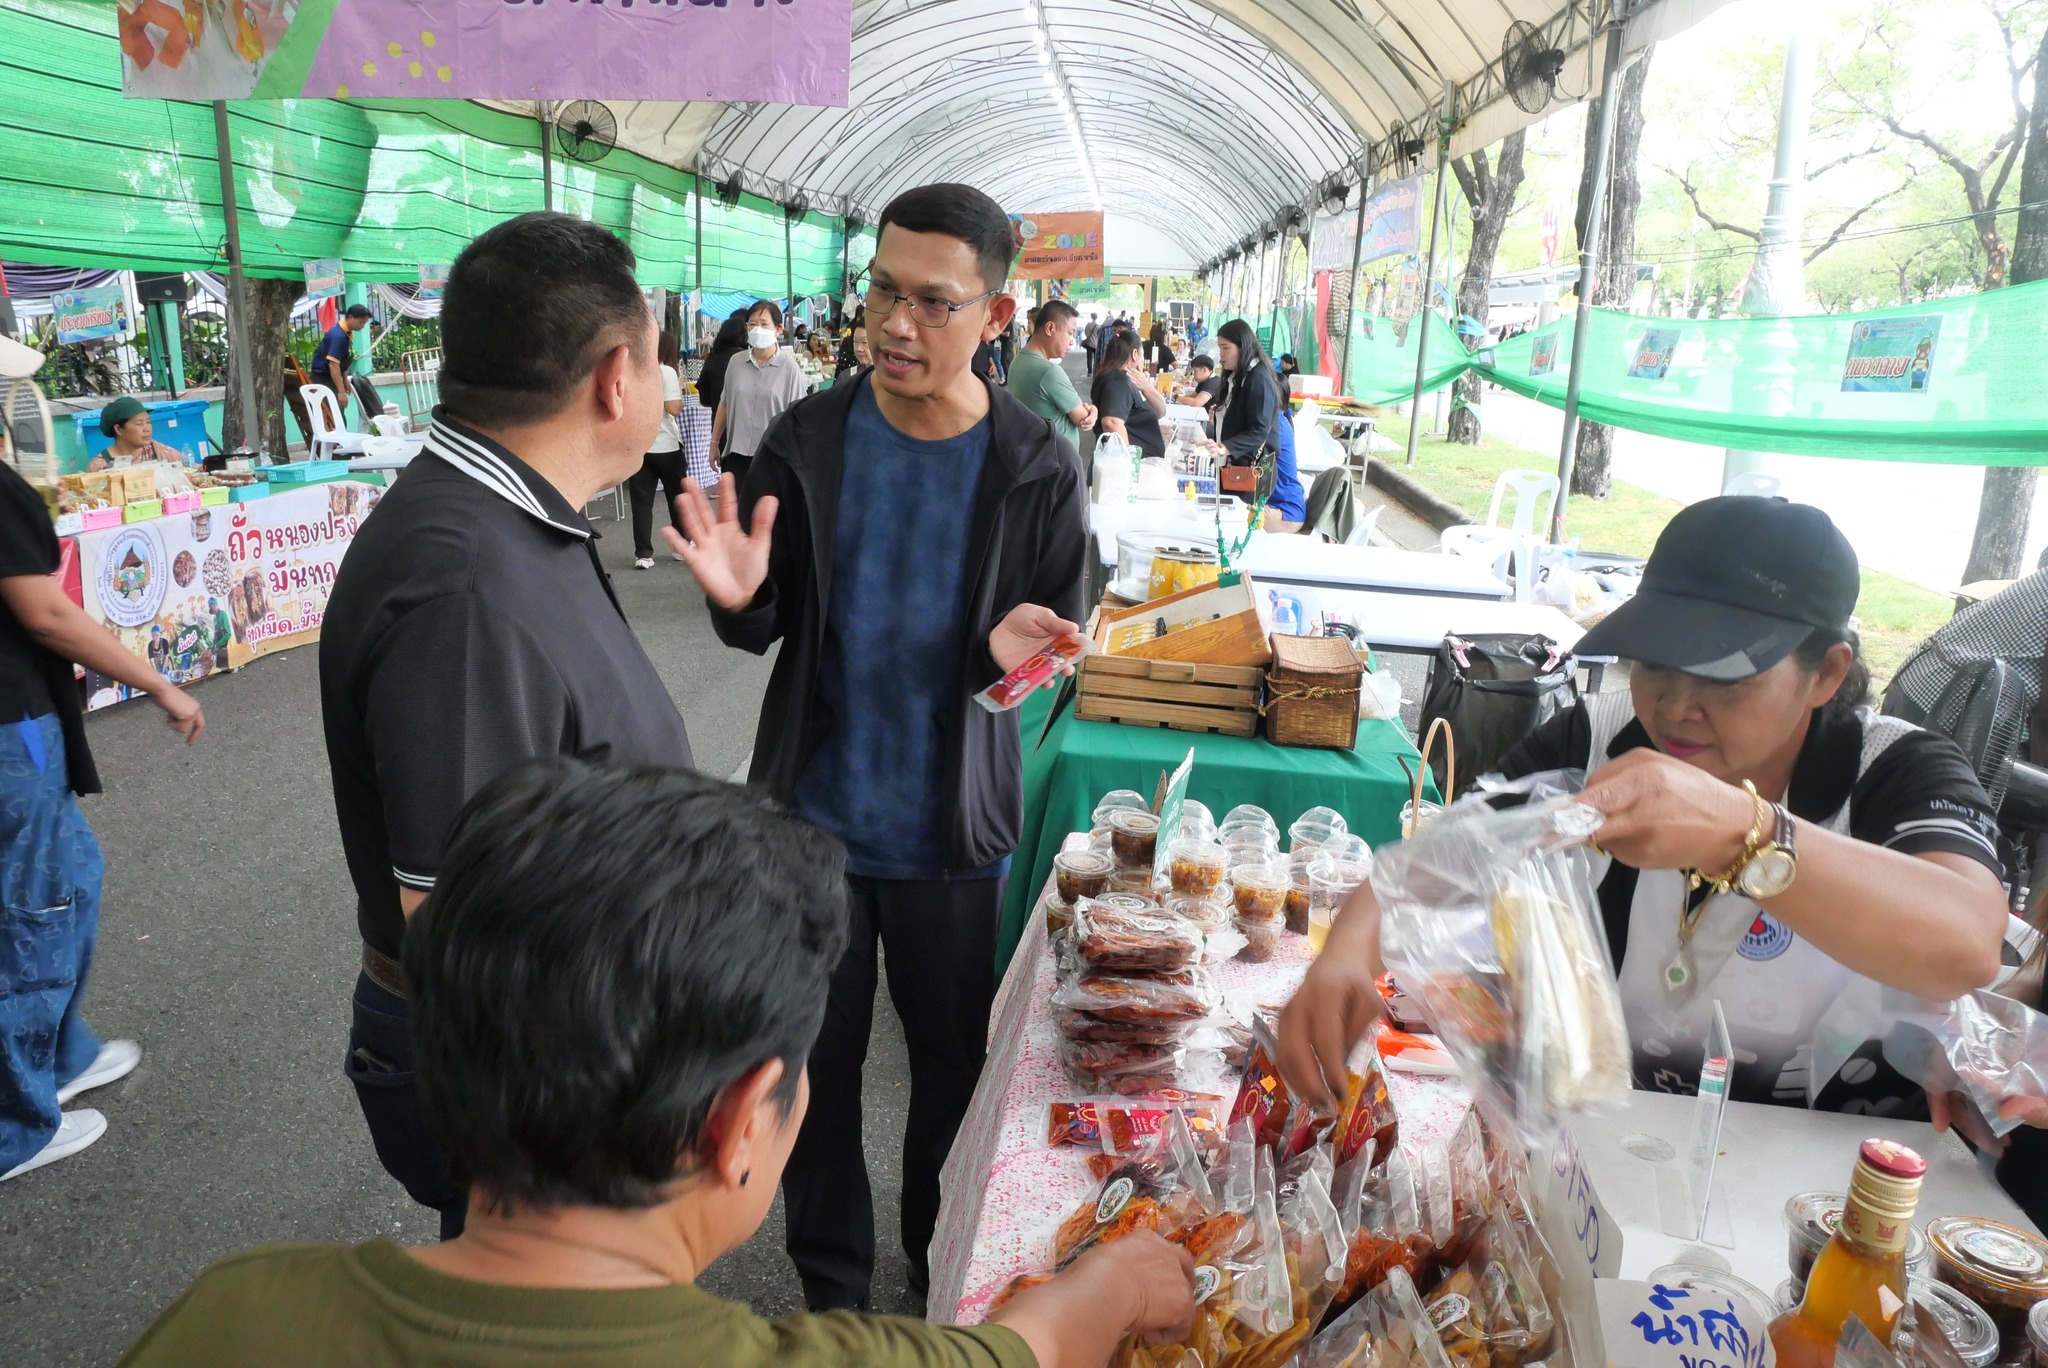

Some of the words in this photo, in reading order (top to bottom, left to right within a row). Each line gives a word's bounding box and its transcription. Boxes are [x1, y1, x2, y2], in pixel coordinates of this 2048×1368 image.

[1043, 232, 1099, 249] ZONE
[1845, 356, 1910, 379] หนองคาย
